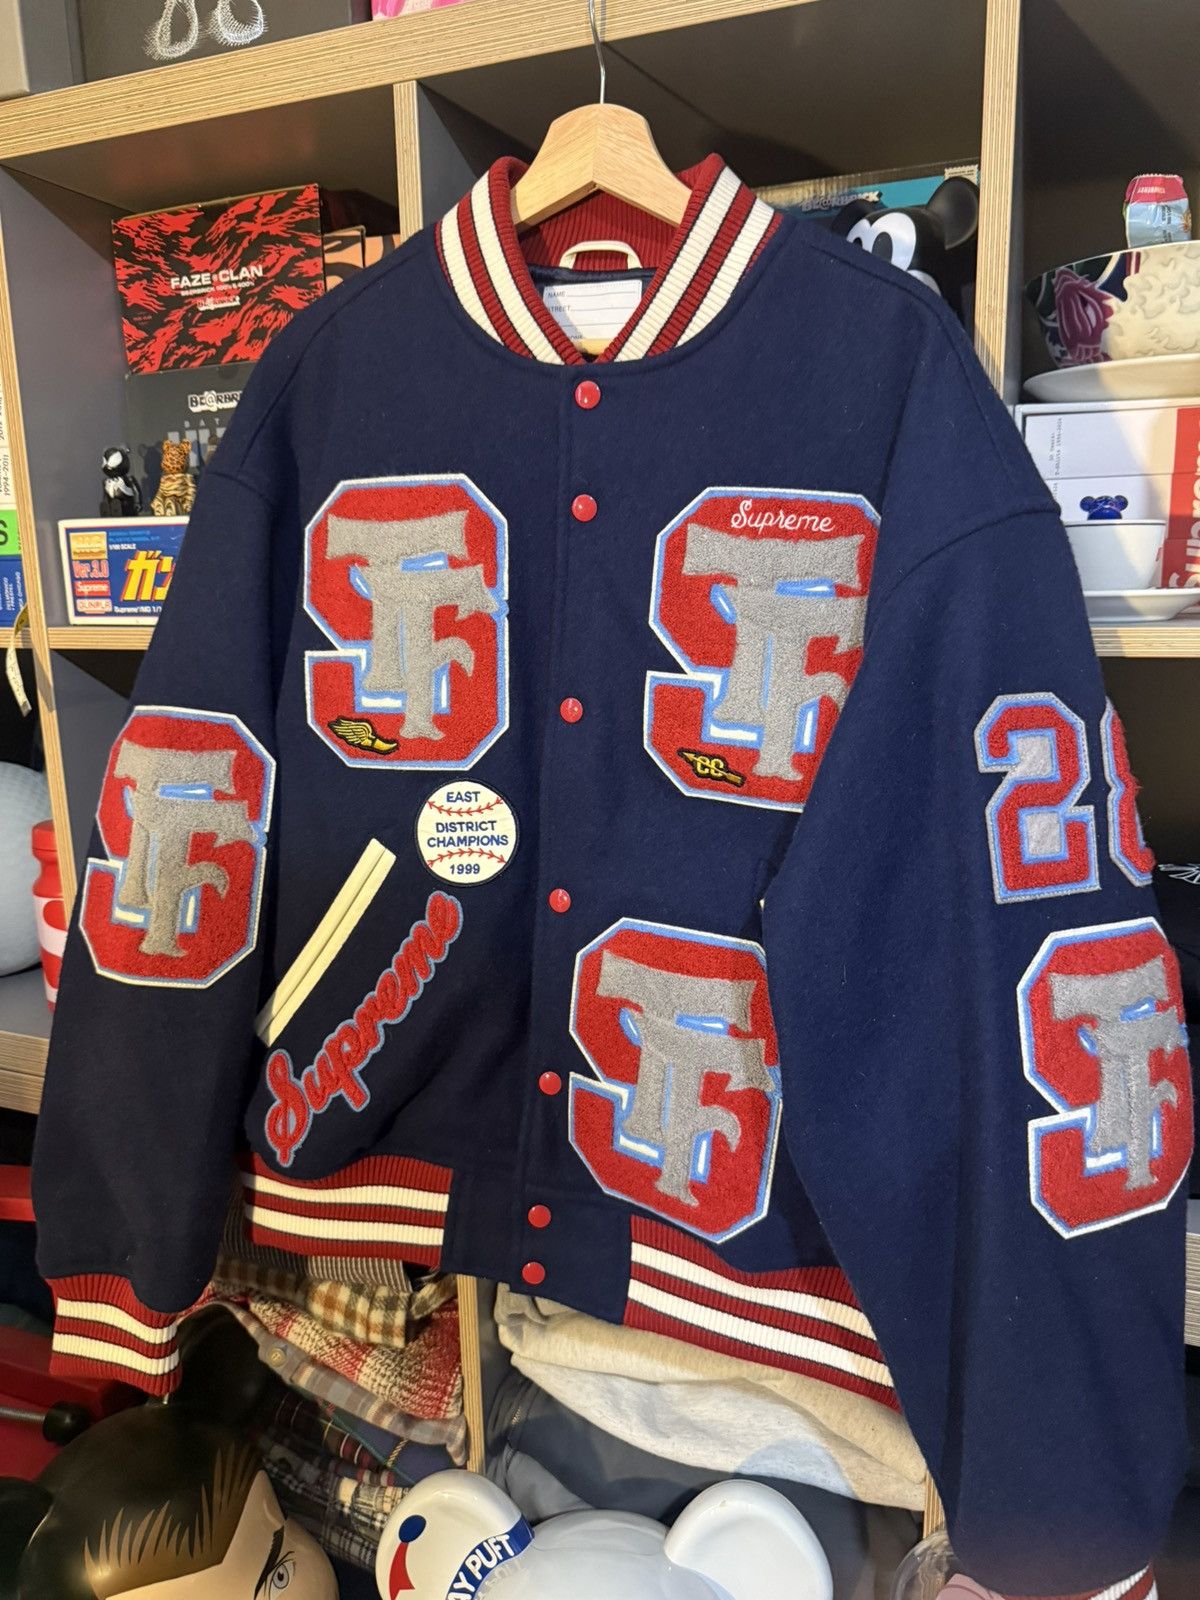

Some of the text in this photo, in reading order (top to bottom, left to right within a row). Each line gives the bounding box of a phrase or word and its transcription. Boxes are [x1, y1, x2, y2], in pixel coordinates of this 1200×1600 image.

[170, 264, 264, 290] FAZE CLAN
[188, 390, 242, 412] BE@RBR
[730, 499, 836, 535] Supreme
[446, 791, 480, 803] EAST
[435, 820, 497, 833] DISTRICT
[427, 834, 509, 848] CHAMPIONS
[449, 863, 480, 875] 1999
[265, 891, 464, 1168] Supreme
[464, 1534, 515, 1581] PUFT
